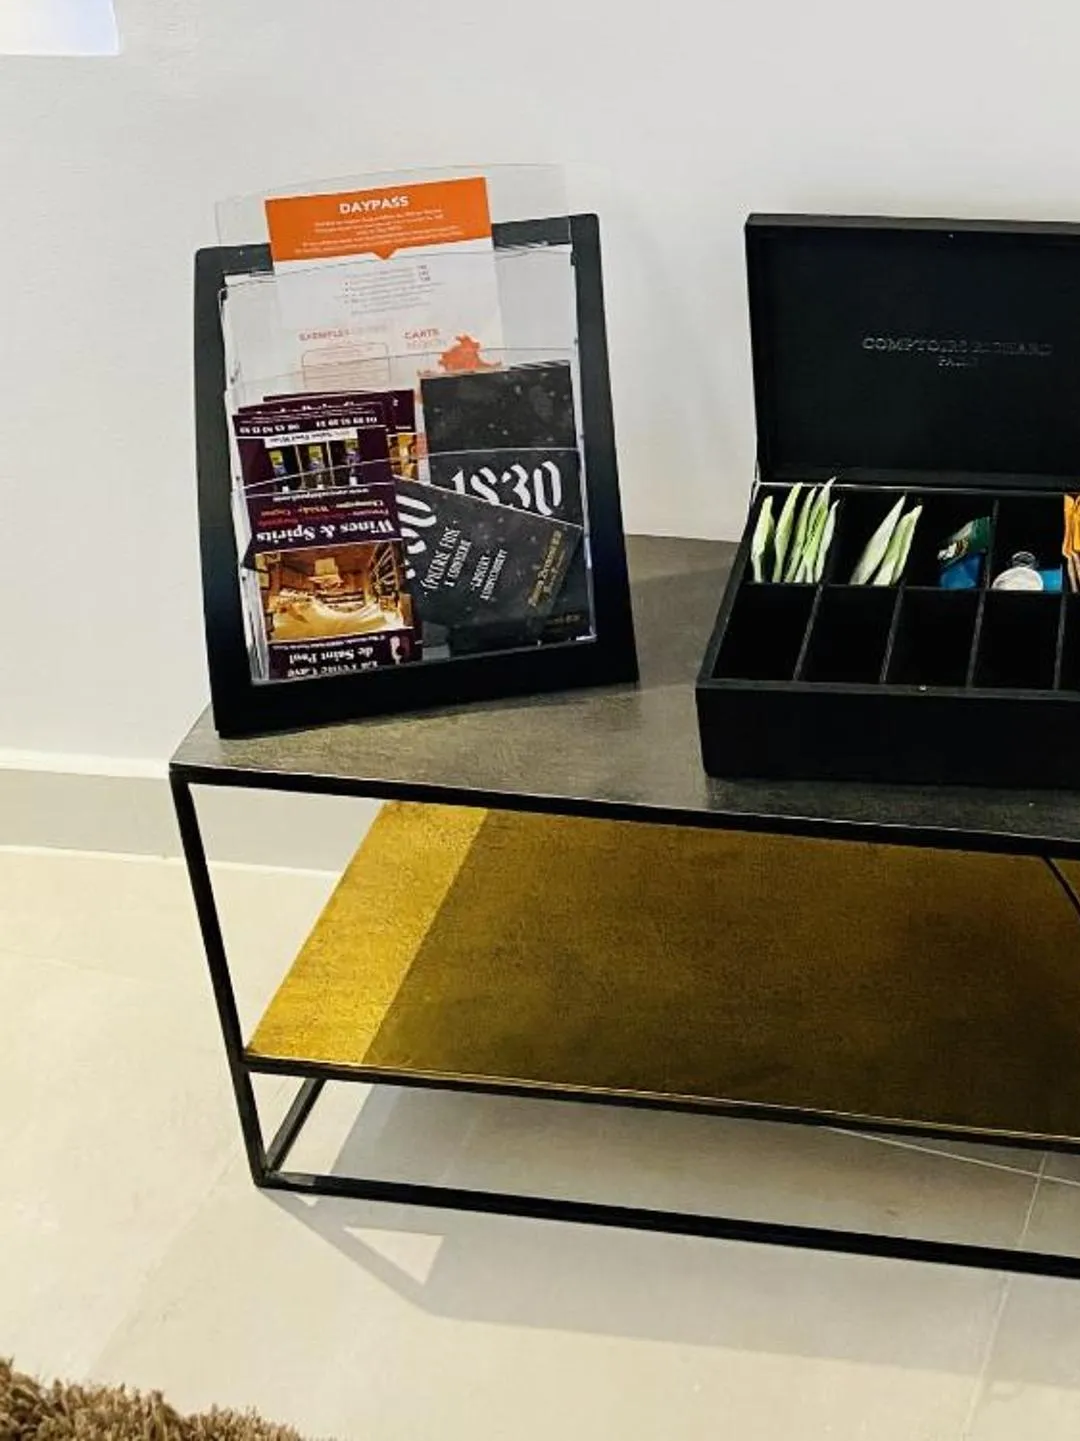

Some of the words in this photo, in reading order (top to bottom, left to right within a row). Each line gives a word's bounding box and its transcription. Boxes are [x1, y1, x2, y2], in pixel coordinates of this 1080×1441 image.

[338, 195, 410, 216] DAYPASS
[319, 524, 337, 539] &
[339, 518, 395, 534] Wines
[256, 524, 316, 545] Spirits
[320, 648, 355, 662] Saint
